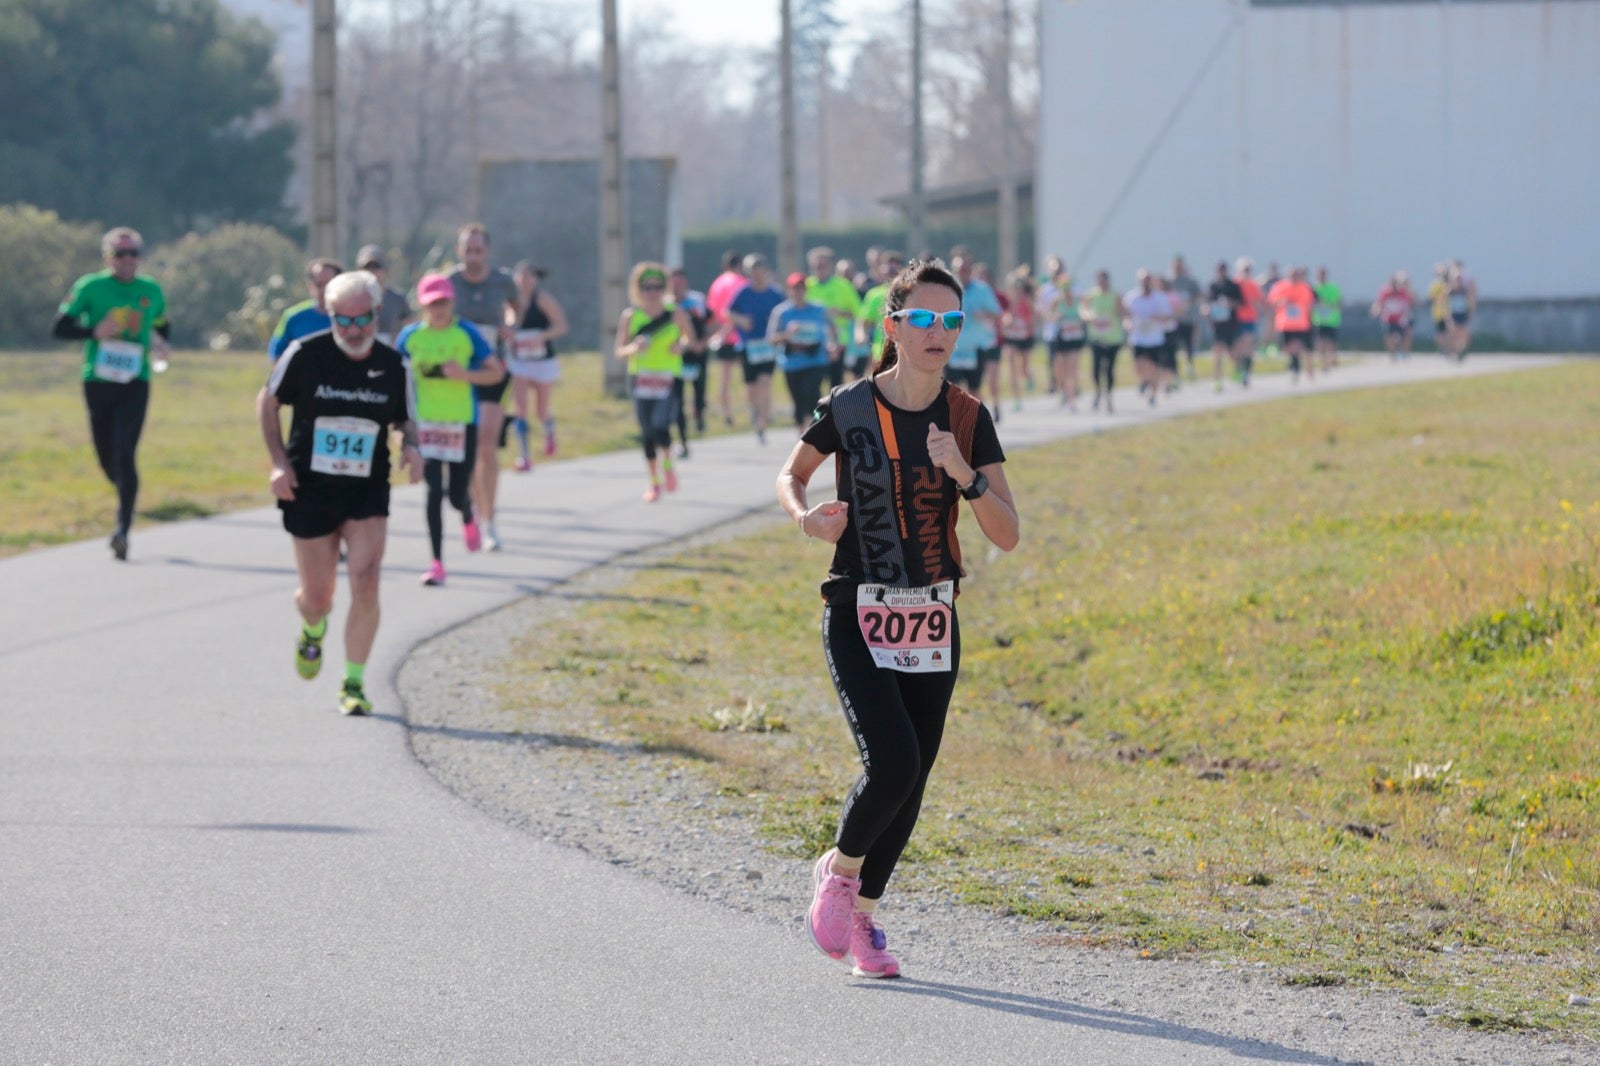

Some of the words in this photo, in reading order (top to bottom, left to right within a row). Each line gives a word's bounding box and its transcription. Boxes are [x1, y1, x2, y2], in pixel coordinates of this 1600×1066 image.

[325, 433, 364, 456] 914
[885, 586, 900, 595] GRAN
[901, 586, 923, 596] PREMIO
[864, 610, 946, 643] 2079
[843, 696, 851, 708] DO
[848, 707, 857, 723] JUST
[857, 733, 867, 749] JUST
[863, 750, 869, 761] DO
